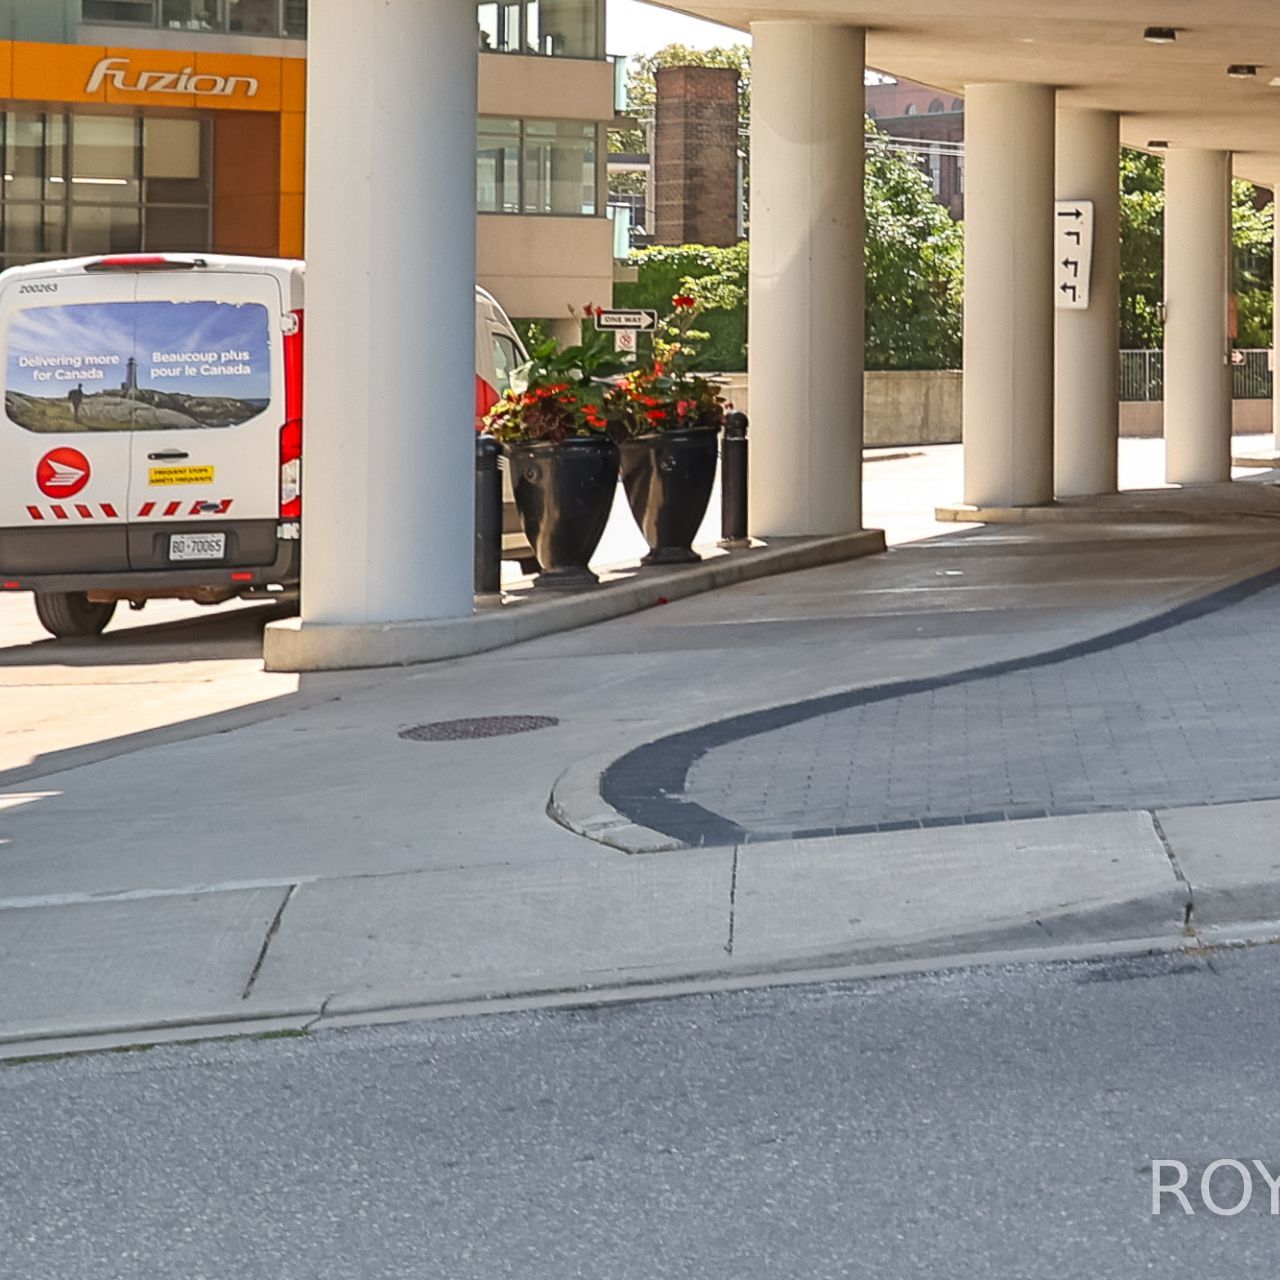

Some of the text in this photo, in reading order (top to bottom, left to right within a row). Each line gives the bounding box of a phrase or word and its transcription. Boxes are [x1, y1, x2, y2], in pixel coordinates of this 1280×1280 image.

[85, 57, 259, 97] fuzion
[19, 355, 120, 369] Delivering more
[152, 349, 250, 364] Beaucoup plus
[33, 367, 104, 381] for Canada
[150, 363, 251, 379] pour le Canada
